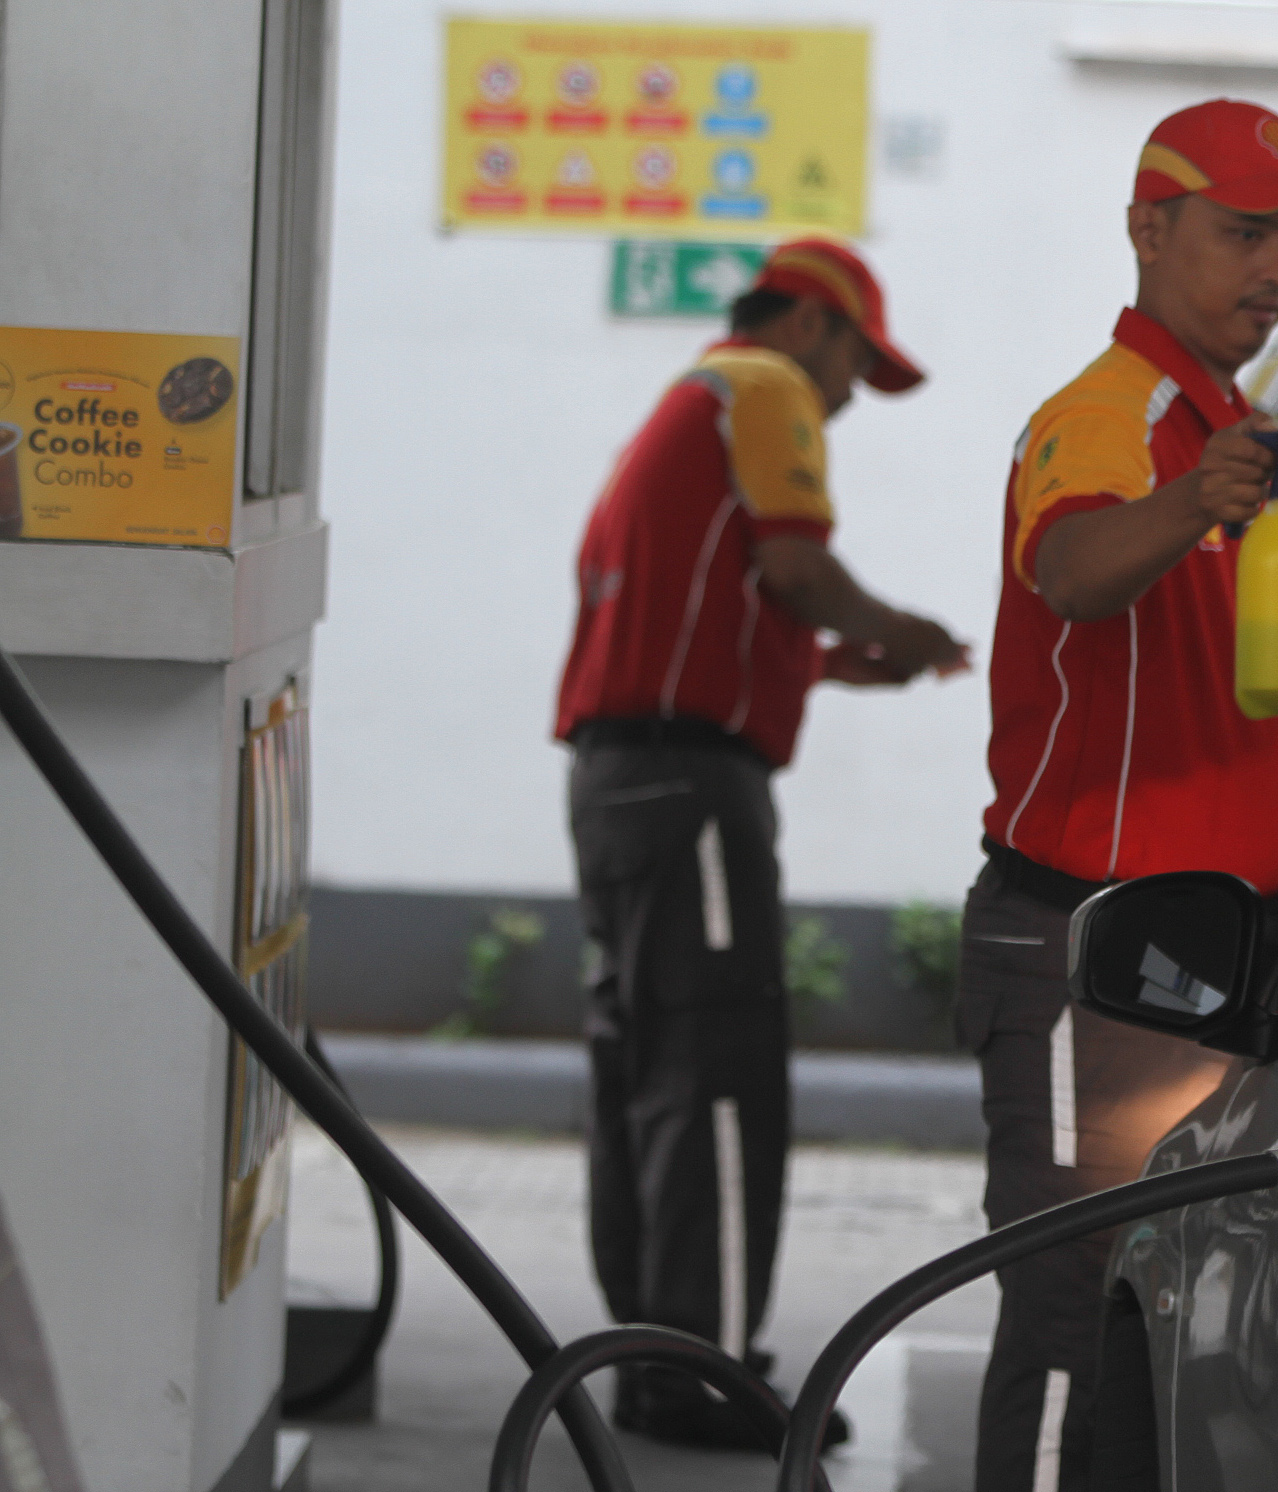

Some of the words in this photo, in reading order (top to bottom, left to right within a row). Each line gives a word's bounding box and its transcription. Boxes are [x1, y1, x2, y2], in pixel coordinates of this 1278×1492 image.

[34, 398, 140, 428] Coffee
[28, 428, 142, 458] Cookie
[34, 459, 134, 489] Combo
